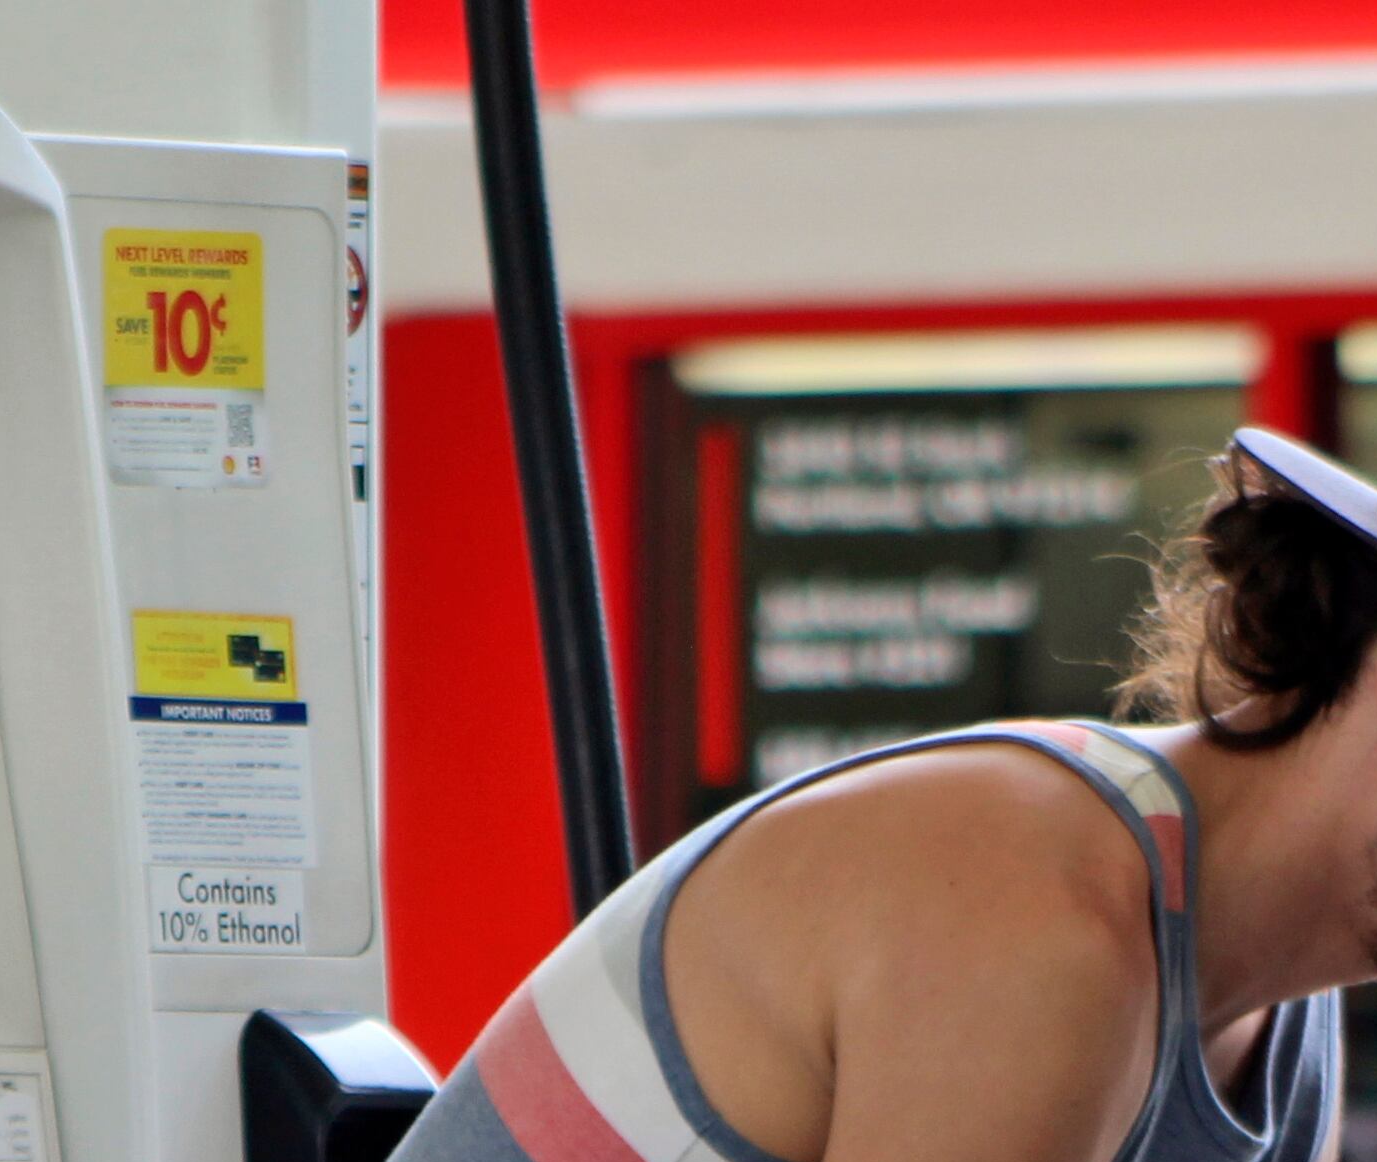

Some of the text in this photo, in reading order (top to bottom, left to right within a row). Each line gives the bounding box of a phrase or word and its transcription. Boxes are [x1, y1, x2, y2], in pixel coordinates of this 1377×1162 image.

[116, 246, 249, 265] NEXT LEVEL REWARDS
[115, 316, 149, 335] SAVE
[146, 289, 228, 377] 10¢
[160, 703, 272, 722] IMPORTANT NOTICES
[177, 872, 278, 906] Contains
[159, 911, 302, 945] 10% Ethanol
